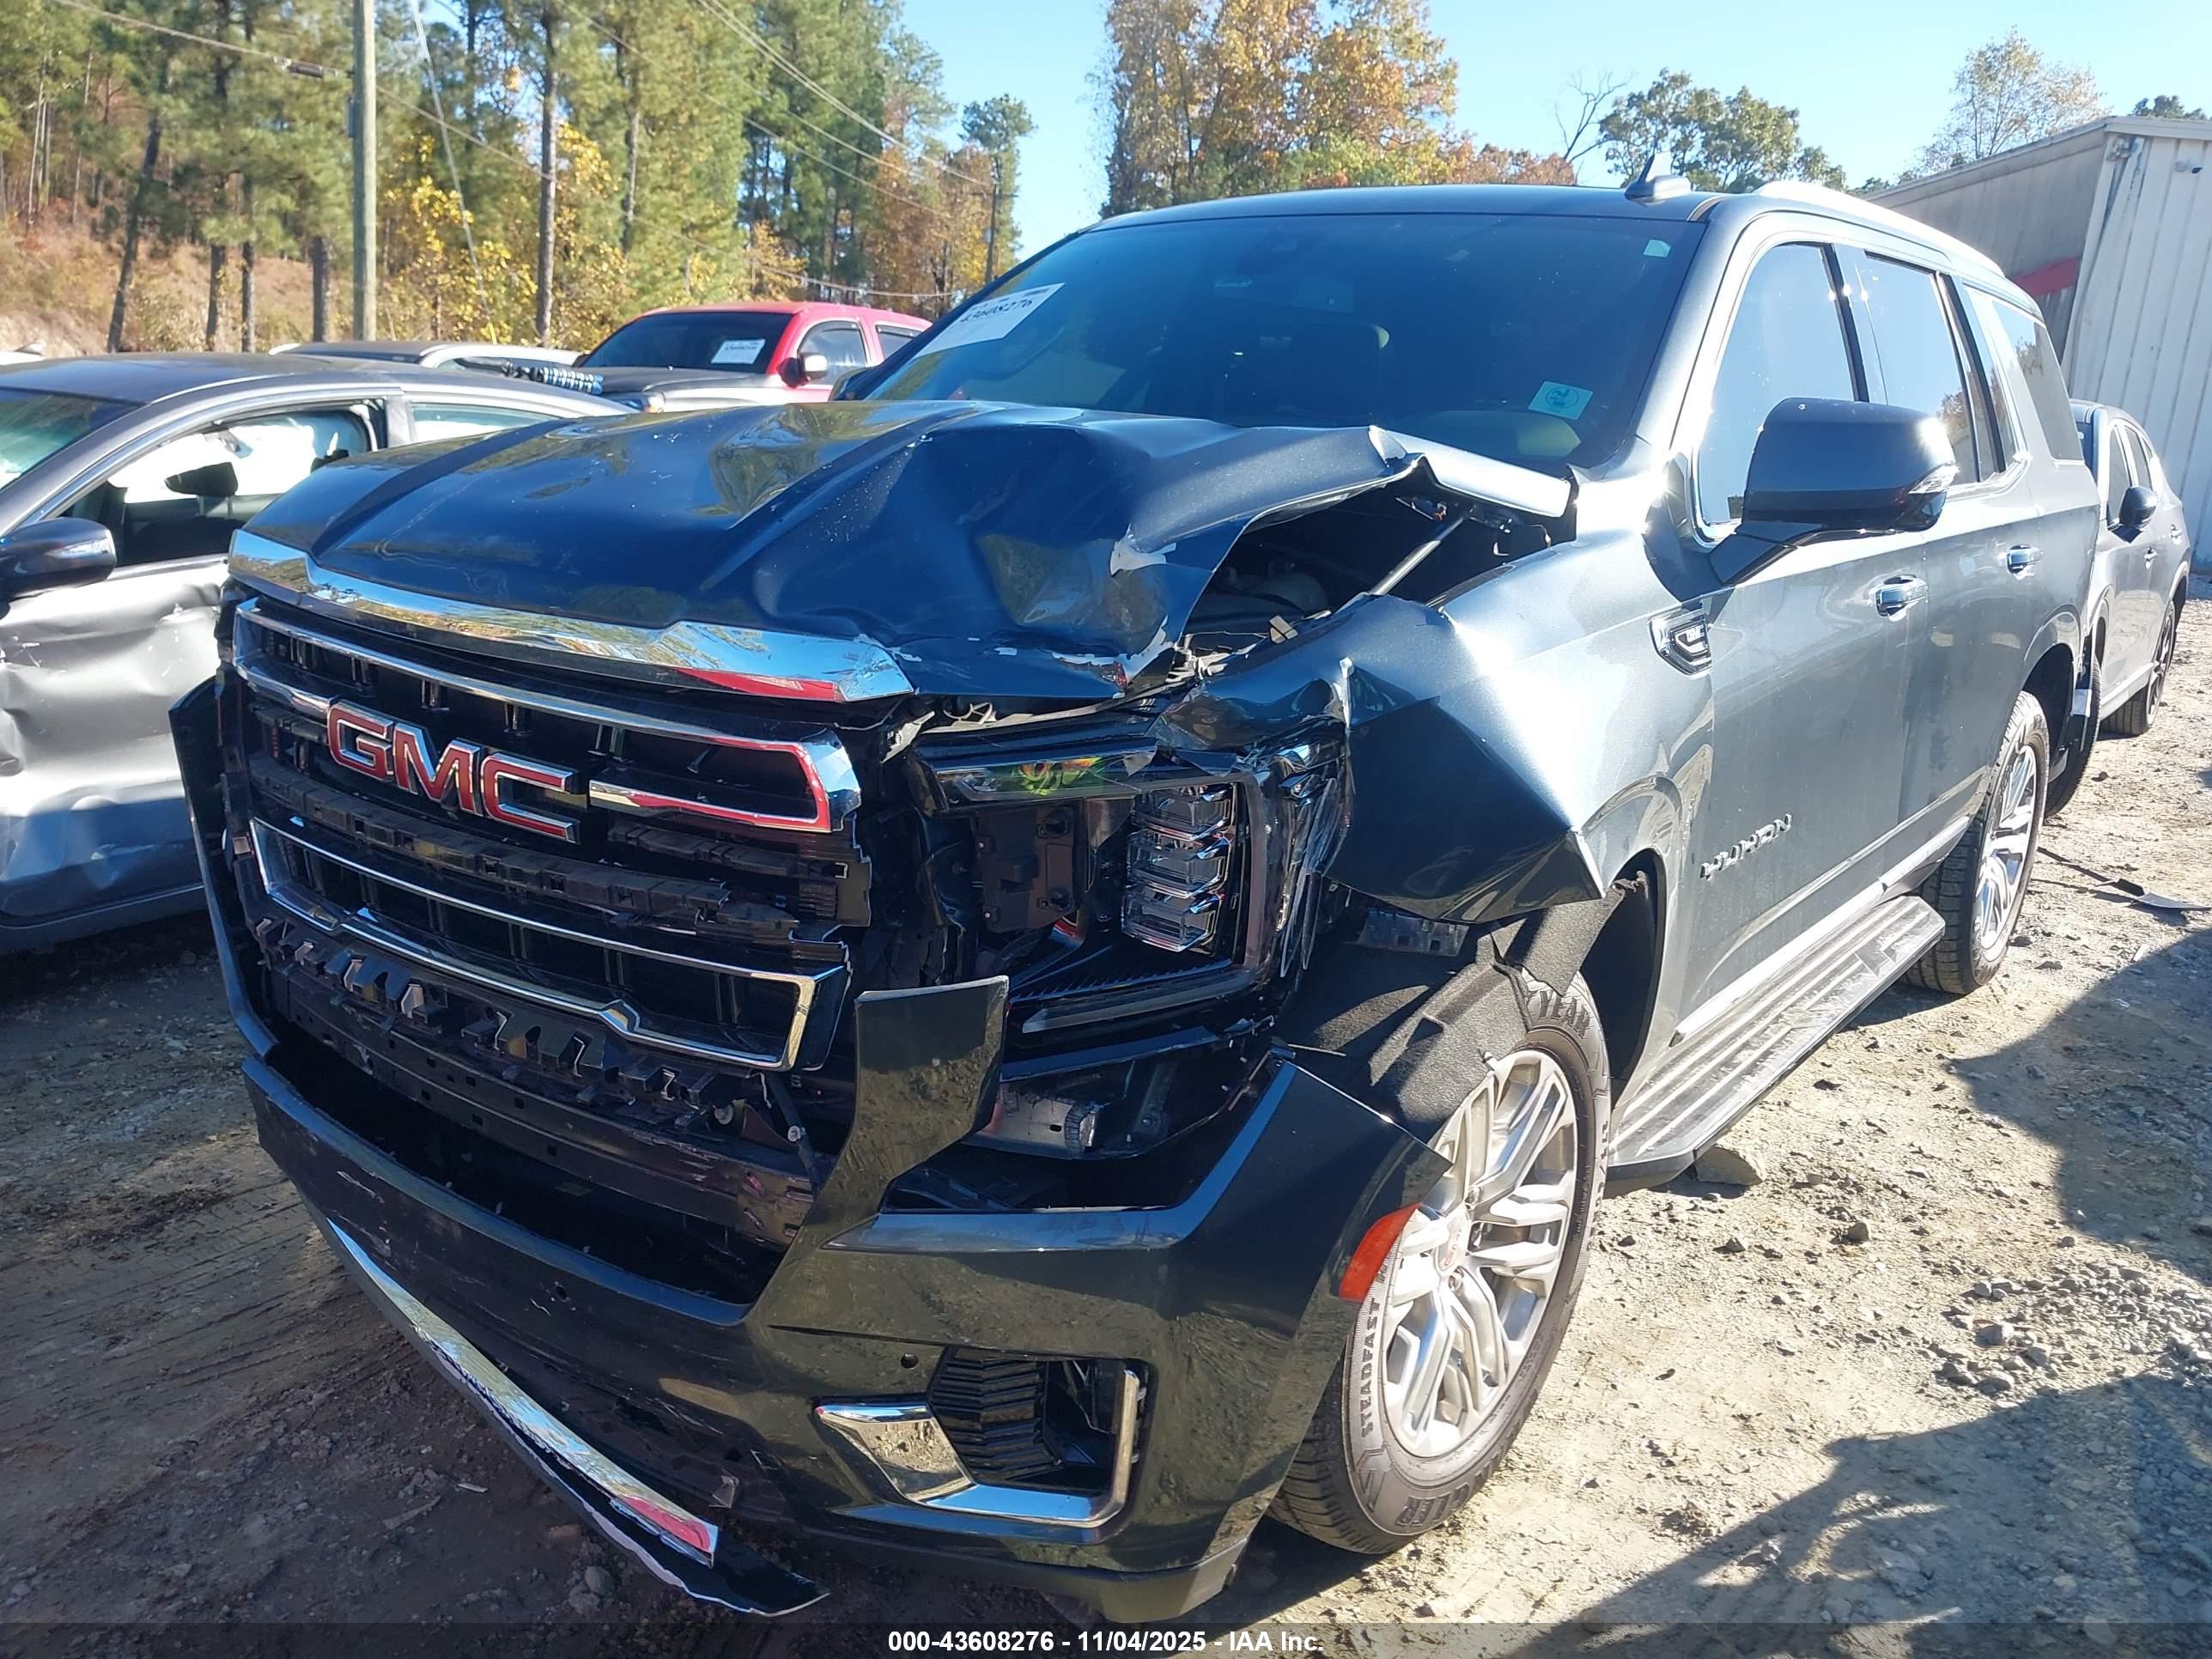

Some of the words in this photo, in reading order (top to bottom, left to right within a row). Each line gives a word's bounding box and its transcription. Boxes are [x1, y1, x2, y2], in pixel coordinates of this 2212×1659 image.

[327, 700, 579, 844] GMC
[1699, 812, 1792, 881] YUKON
[1360, 1297, 1382, 1438] STEADFAST
